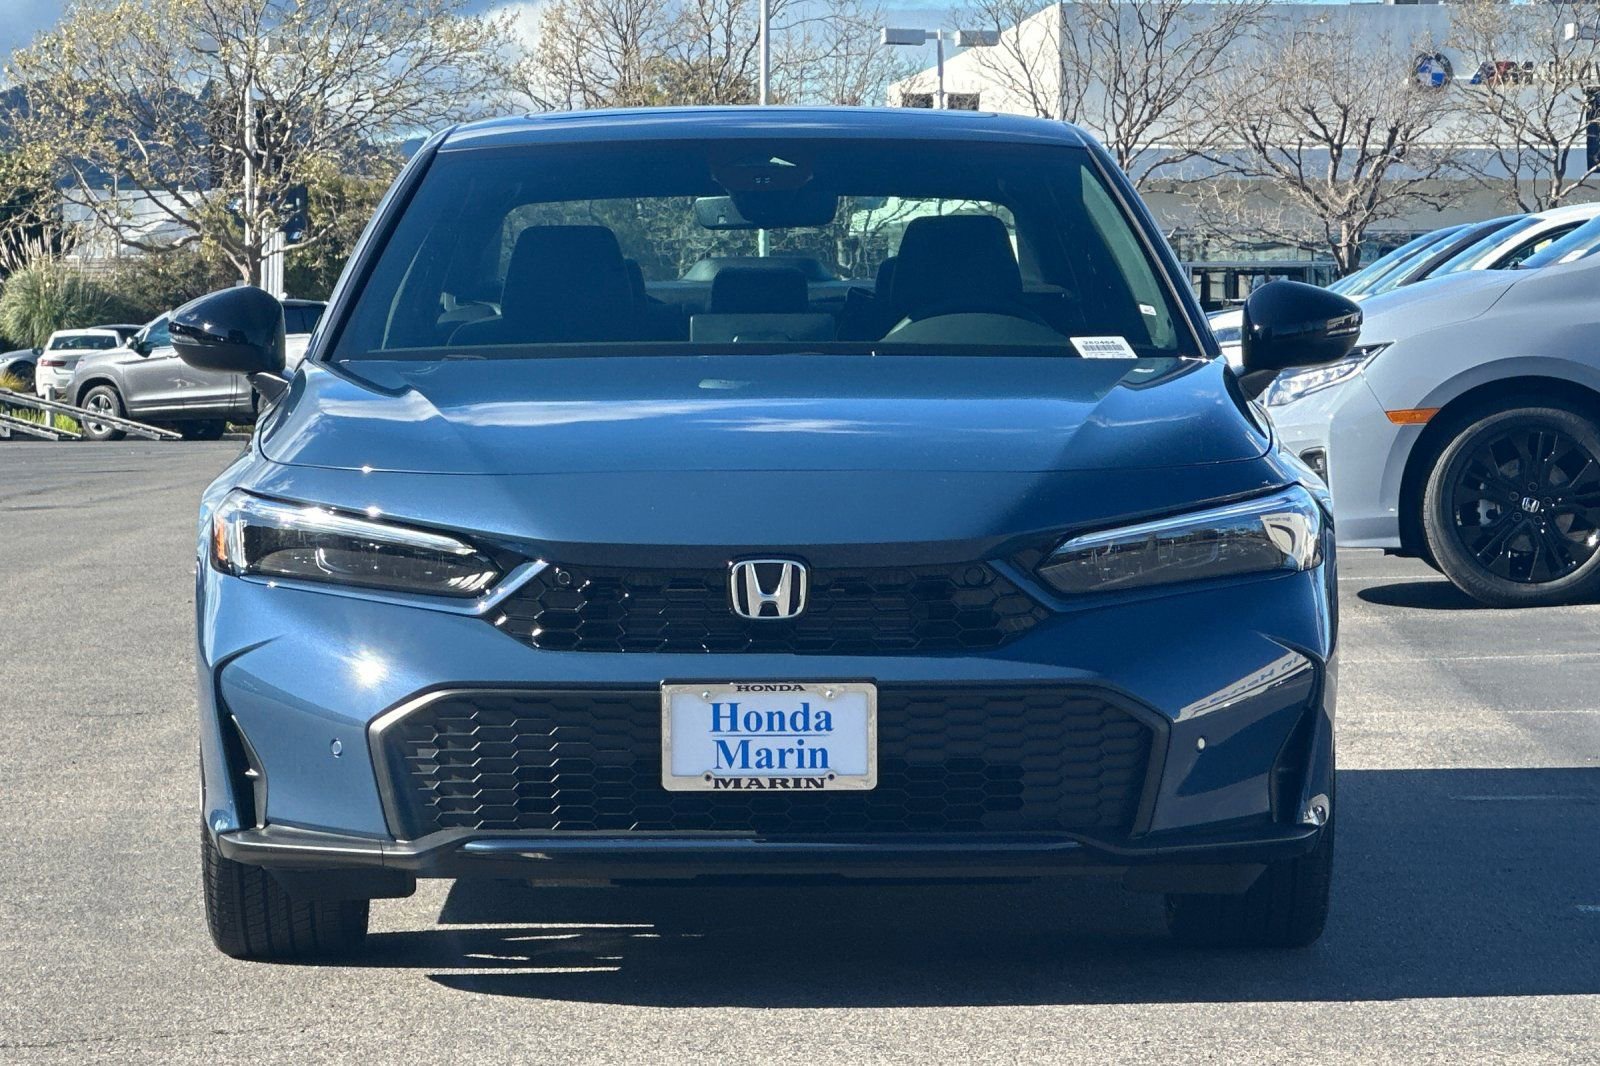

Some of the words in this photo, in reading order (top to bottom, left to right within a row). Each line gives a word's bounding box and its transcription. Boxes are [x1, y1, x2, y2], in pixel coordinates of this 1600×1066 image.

[736, 684, 806, 692] HONDA
[708, 702, 834, 733] Honda
[712, 738, 831, 770] Marin
[713, 777, 827, 790] MARIN
